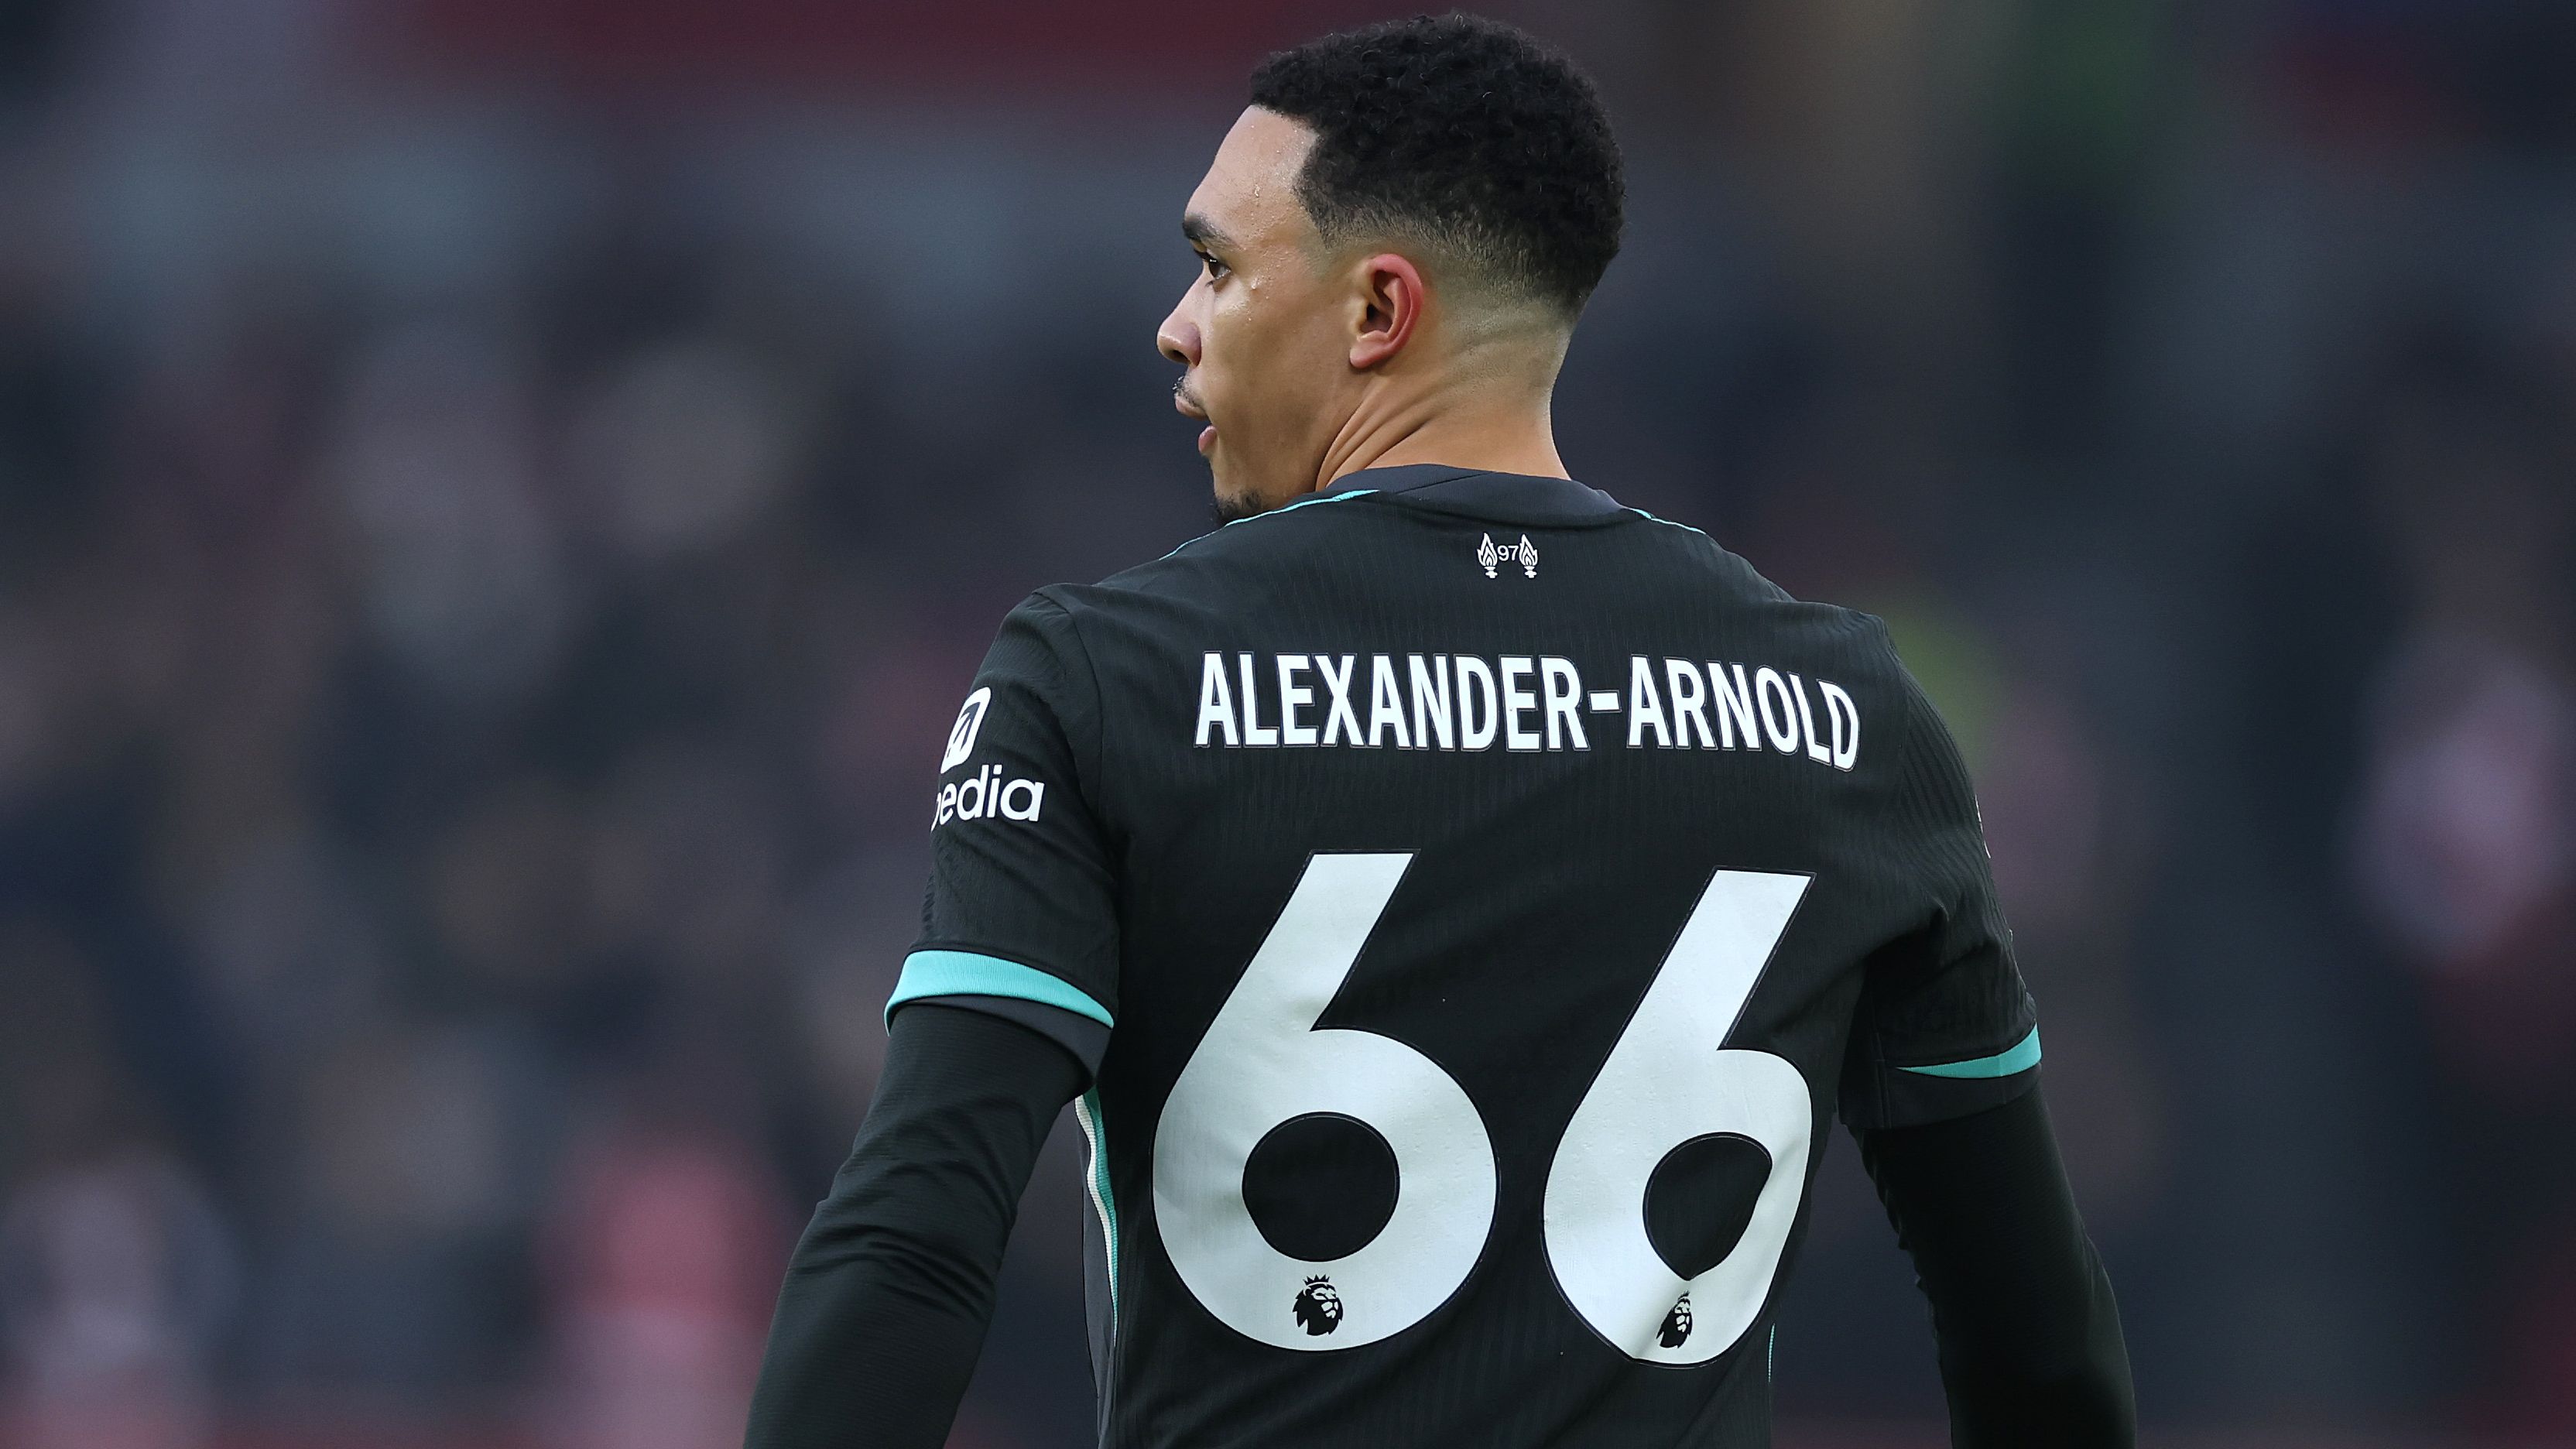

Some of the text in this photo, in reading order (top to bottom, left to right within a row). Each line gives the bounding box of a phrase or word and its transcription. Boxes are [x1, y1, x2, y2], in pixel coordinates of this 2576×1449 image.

[1497, 545, 1519, 561] 97
[1194, 652, 1860, 771] ALEXANDER-ARNOLD
[1152, 850, 1815, 1367] 66
